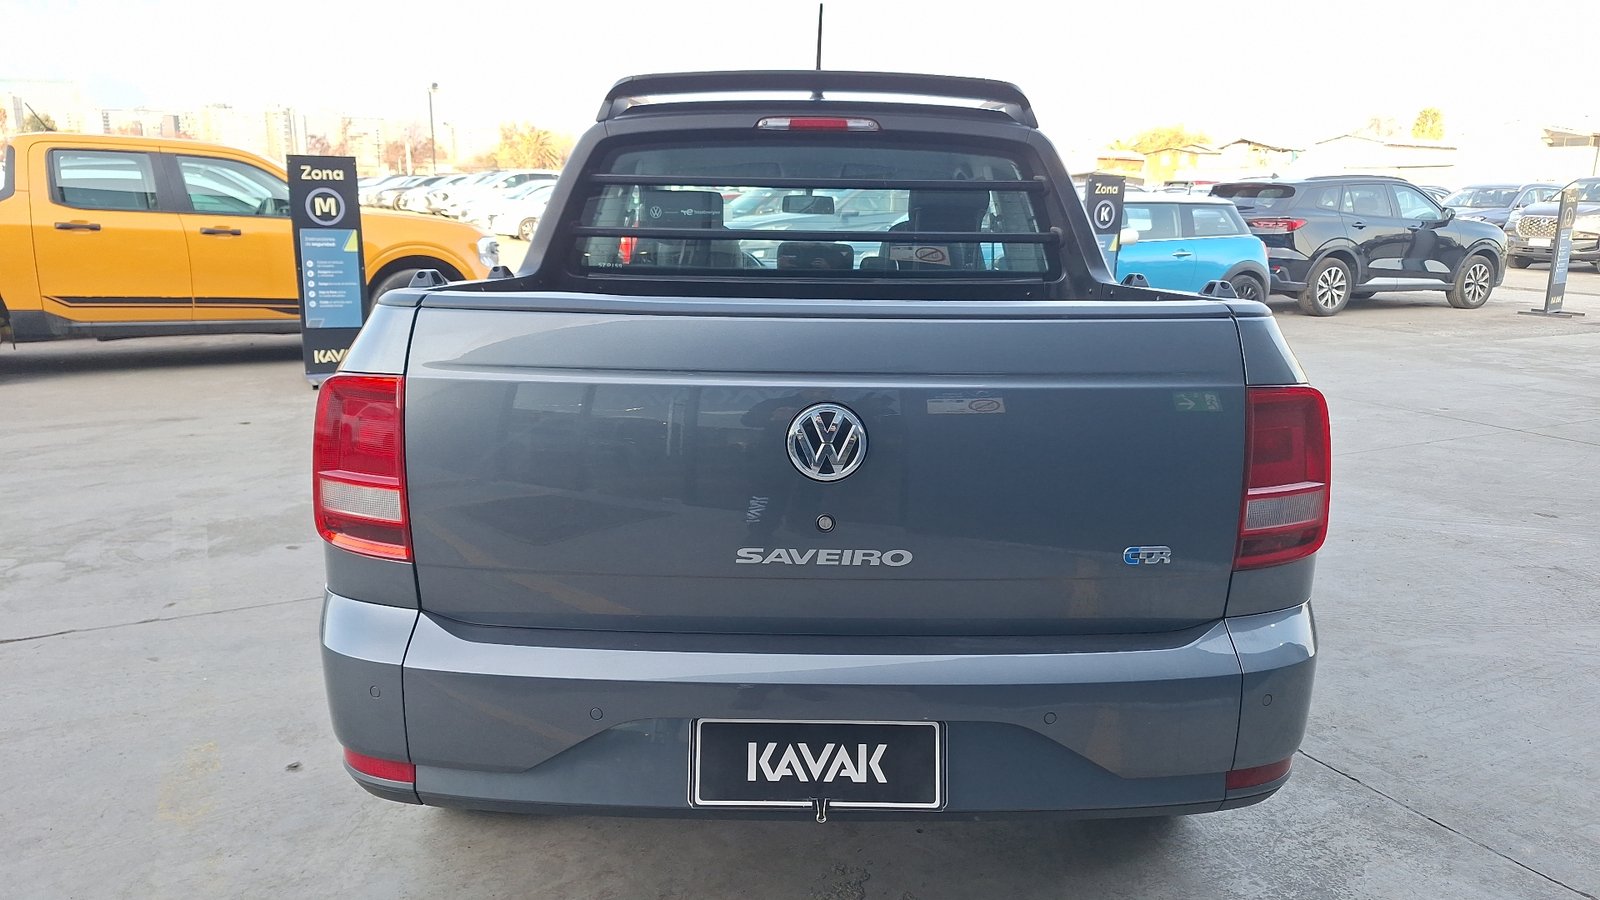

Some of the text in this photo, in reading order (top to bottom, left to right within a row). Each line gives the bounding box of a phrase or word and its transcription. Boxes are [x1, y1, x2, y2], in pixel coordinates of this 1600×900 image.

[300, 165, 344, 180] Zona
[1095, 184, 1118, 194] Zona
[314, 197, 337, 216] M
[1100, 207, 1110, 221] K
[313, 348, 350, 364] KAV
[735, 547, 913, 567] SAVEIRO
[747, 742, 888, 784] KAVAK
